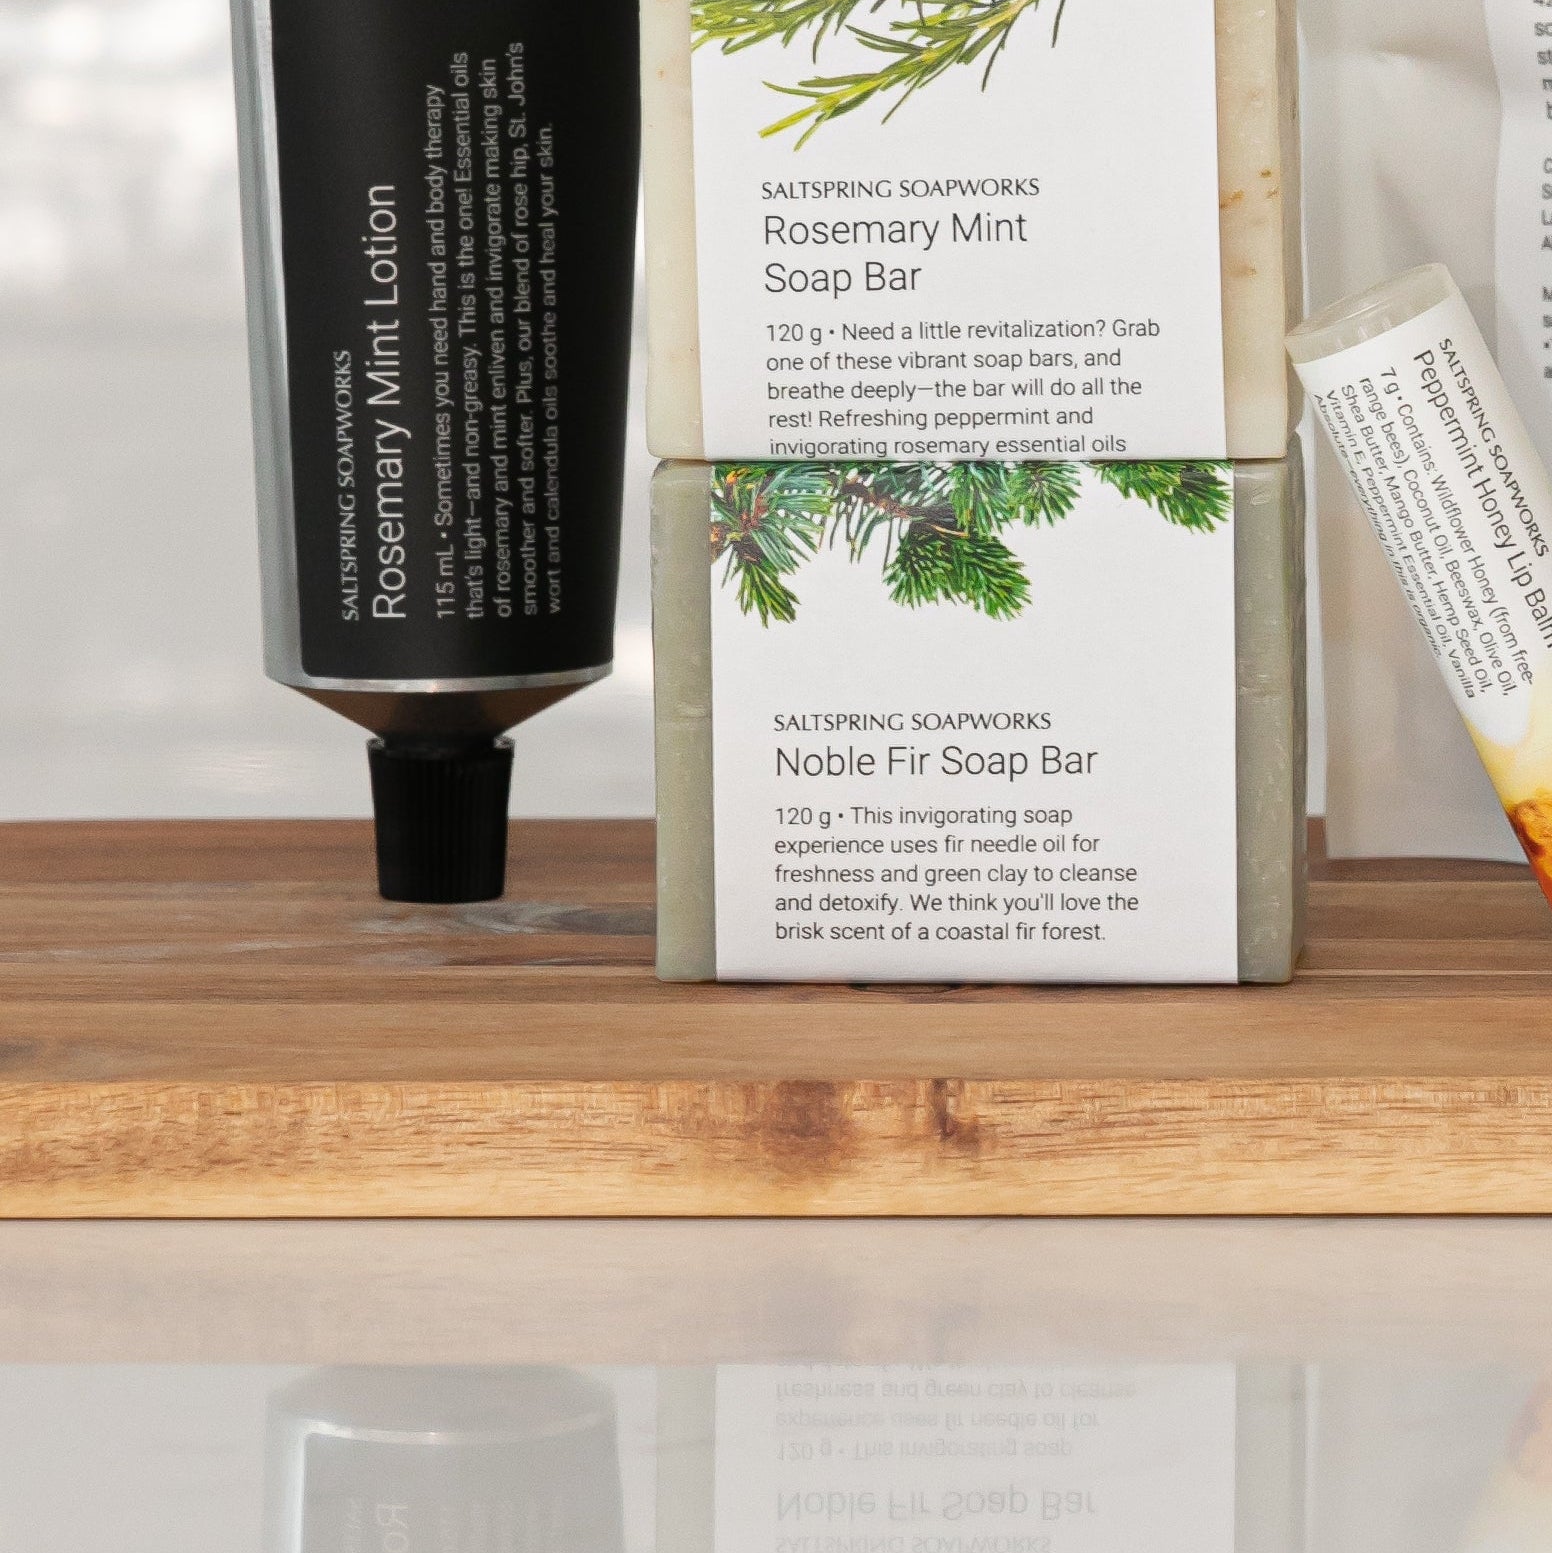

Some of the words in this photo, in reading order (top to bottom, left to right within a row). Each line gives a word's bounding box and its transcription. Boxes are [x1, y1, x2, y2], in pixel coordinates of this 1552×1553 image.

[449, 51, 469, 87] oils
[423, 84, 445, 159] therapy
[450, 92, 472, 181] Essential
[423, 164, 447, 212] body
[762, 179, 891, 199] SALTSPRING
[899, 178, 1039, 197] SOAPWORKS
[455, 188, 474, 230] one!
[361, 184, 398, 305] Lotion
[425, 218, 445, 255] and
[455, 235, 474, 267] the
[765, 215, 939, 251] Rosemary
[952, 212, 1027, 242] Mint
[426, 261, 446, 310] hand
[457, 272, 475, 288] is
[765, 262, 851, 299] Soap
[865, 261, 922, 291] Bar
[458, 294, 476, 337] This
[766, 323, 803, 341] 120
[810, 327, 821, 345] g
[842, 321, 894, 340] Need
[901, 326, 912, 339] a
[919, 321, 961, 339] little
[967, 319, 1105, 338] revitalization?
[1112, 318, 1160, 337] Grab
[428, 317, 448, 364] need
[766, 357, 804, 371] one
[809, 351, 830, 370] of
[836, 352, 892, 370] these
[897, 351, 967, 369] vibrant
[973, 353, 1022, 371] soap
[1029, 348, 1077, 369] bars,
[1084, 347, 1120, 366] and
[365, 319, 400, 404] Mint
[1380, 366, 1396, 376] 7
[435, 371, 454, 407] you
[462, 343, 483, 456] non-greasy.
[767, 381, 844, 399] breathe
[973, 379, 1005, 396] bar
[1011, 378, 1043, 396] will
[1050, 377, 1075, 395] do
[1082, 377, 1103, 395] all
[1109, 377, 1141, 395] the
[1383, 382, 1400, 394] g
[333, 350, 354, 487] SOAPWORKS
[769, 410, 811, 427] rest!
[819, 408, 927, 430] Refreshing
[934, 407, 1050, 430] peppermint
[1056, 406, 1093, 424] and
[1397, 403, 1437, 475] Contains:
[1438, 338, 1495, 443] SALTSPRING
[1488, 444, 1549, 557] SOAPWORKS
[432, 412, 453, 525] Sometimes
[1413, 349, 1483, 478] Peppermint
[1472, 477, 1516, 548] Honey
[1506, 550, 1532, 587] Lip
[372, 418, 411, 617] Rosemary
[1430, 474, 1475, 553] Wildflower
[1358, 377, 1386, 420] range
[1380, 421, 1409, 468] bees),
[1403, 469, 1441, 533] Coconut
[1433, 534, 1453, 559] Oil,
[1444, 559, 1483, 631] Beeswax,
[1479, 631, 1502, 669] Olive
[1497, 670, 1517, 696] Oil,
[338, 494, 359, 620] SALTSPRING
[434, 543, 454, 575] mL
[1467, 555, 1498, 603] Honey
[435, 581, 455, 618] 115
[1488, 606, 1517, 649] (from
[1511, 649, 1532, 685] free-
[774, 713, 903, 731] SALTSPRING
[911, 712, 1051, 730] SOAPWORKS
[776, 745, 875, 776] Noble
[888, 746, 930, 775] Fir
[941, 745, 1028, 782] Soap
[1042, 745, 1098, 774] Bar
[775, 807, 812, 825] 120
[819, 811, 830, 829] g
[850, 806, 892, 824] This
[899, 806, 1016, 828] invigorating
[1023, 809, 1072, 827] soap
[774, 836, 884, 858] experience
[890, 839, 937, 853] uses
[944, 834, 964, 852] fir
[971, 834, 1037, 852] needle
[1042, 834, 1065, 852] oil
[1071, 833, 1100, 852] for
[774, 863, 874, 882] freshness
[880, 864, 917, 882] and
[924, 868, 980, 886] green
[987, 863, 1028, 886] clay
[1033, 865, 1053, 881] to
[1059, 863, 1137, 881] cleanse
